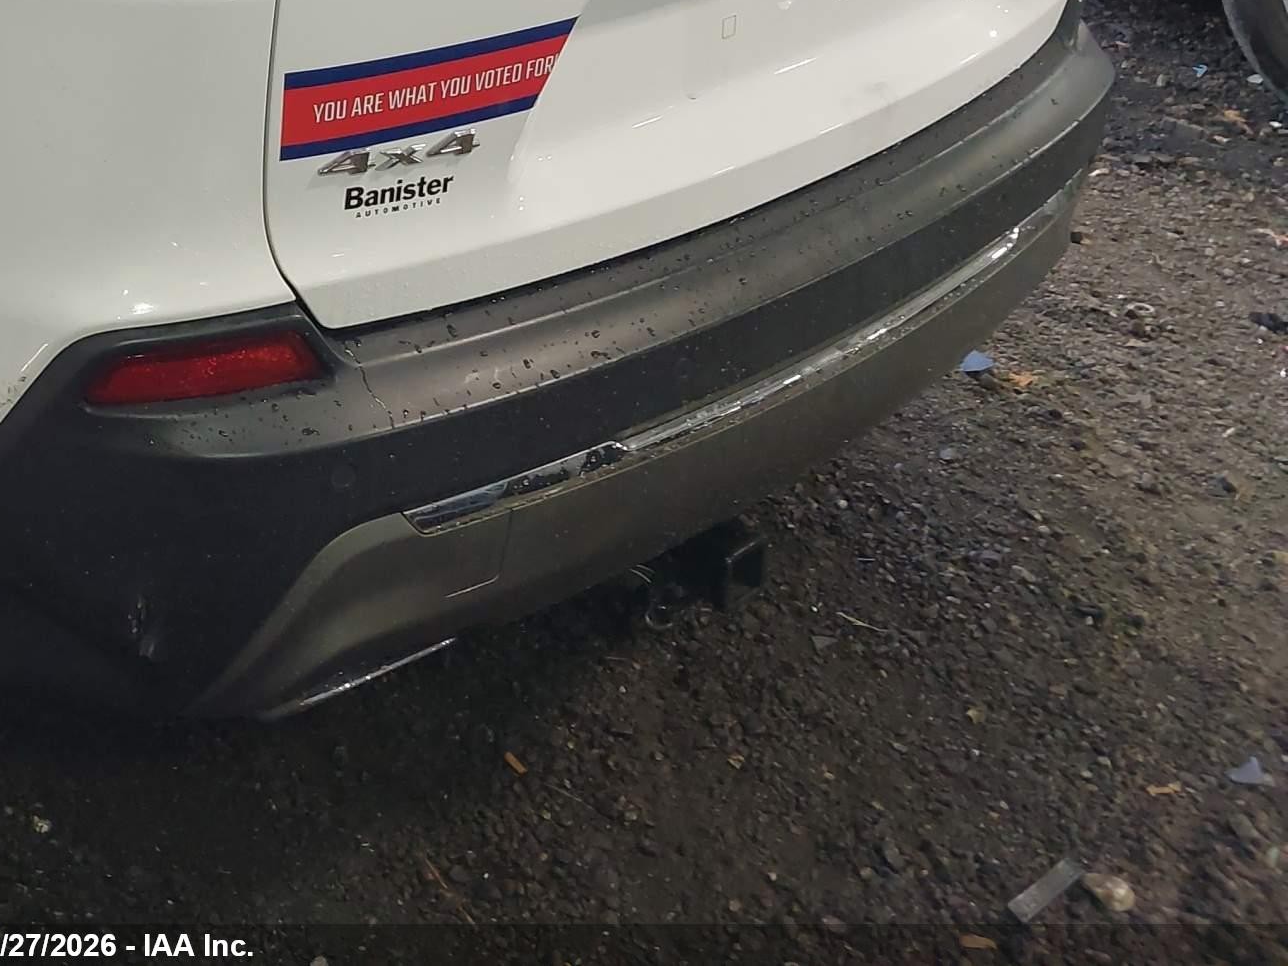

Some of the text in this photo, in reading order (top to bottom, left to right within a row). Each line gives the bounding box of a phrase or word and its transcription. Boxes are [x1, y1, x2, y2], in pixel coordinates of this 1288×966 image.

[313, 99, 347, 123] YOU
[351, 92, 385, 117] ARE
[388, 82, 438, 110] WHAT
[440, 75, 472, 99] YOU
[475, 62, 523, 90] VOTED
[344, 175, 454, 210] Banister
[355, 197, 441, 219] AUTOMOTIVE
